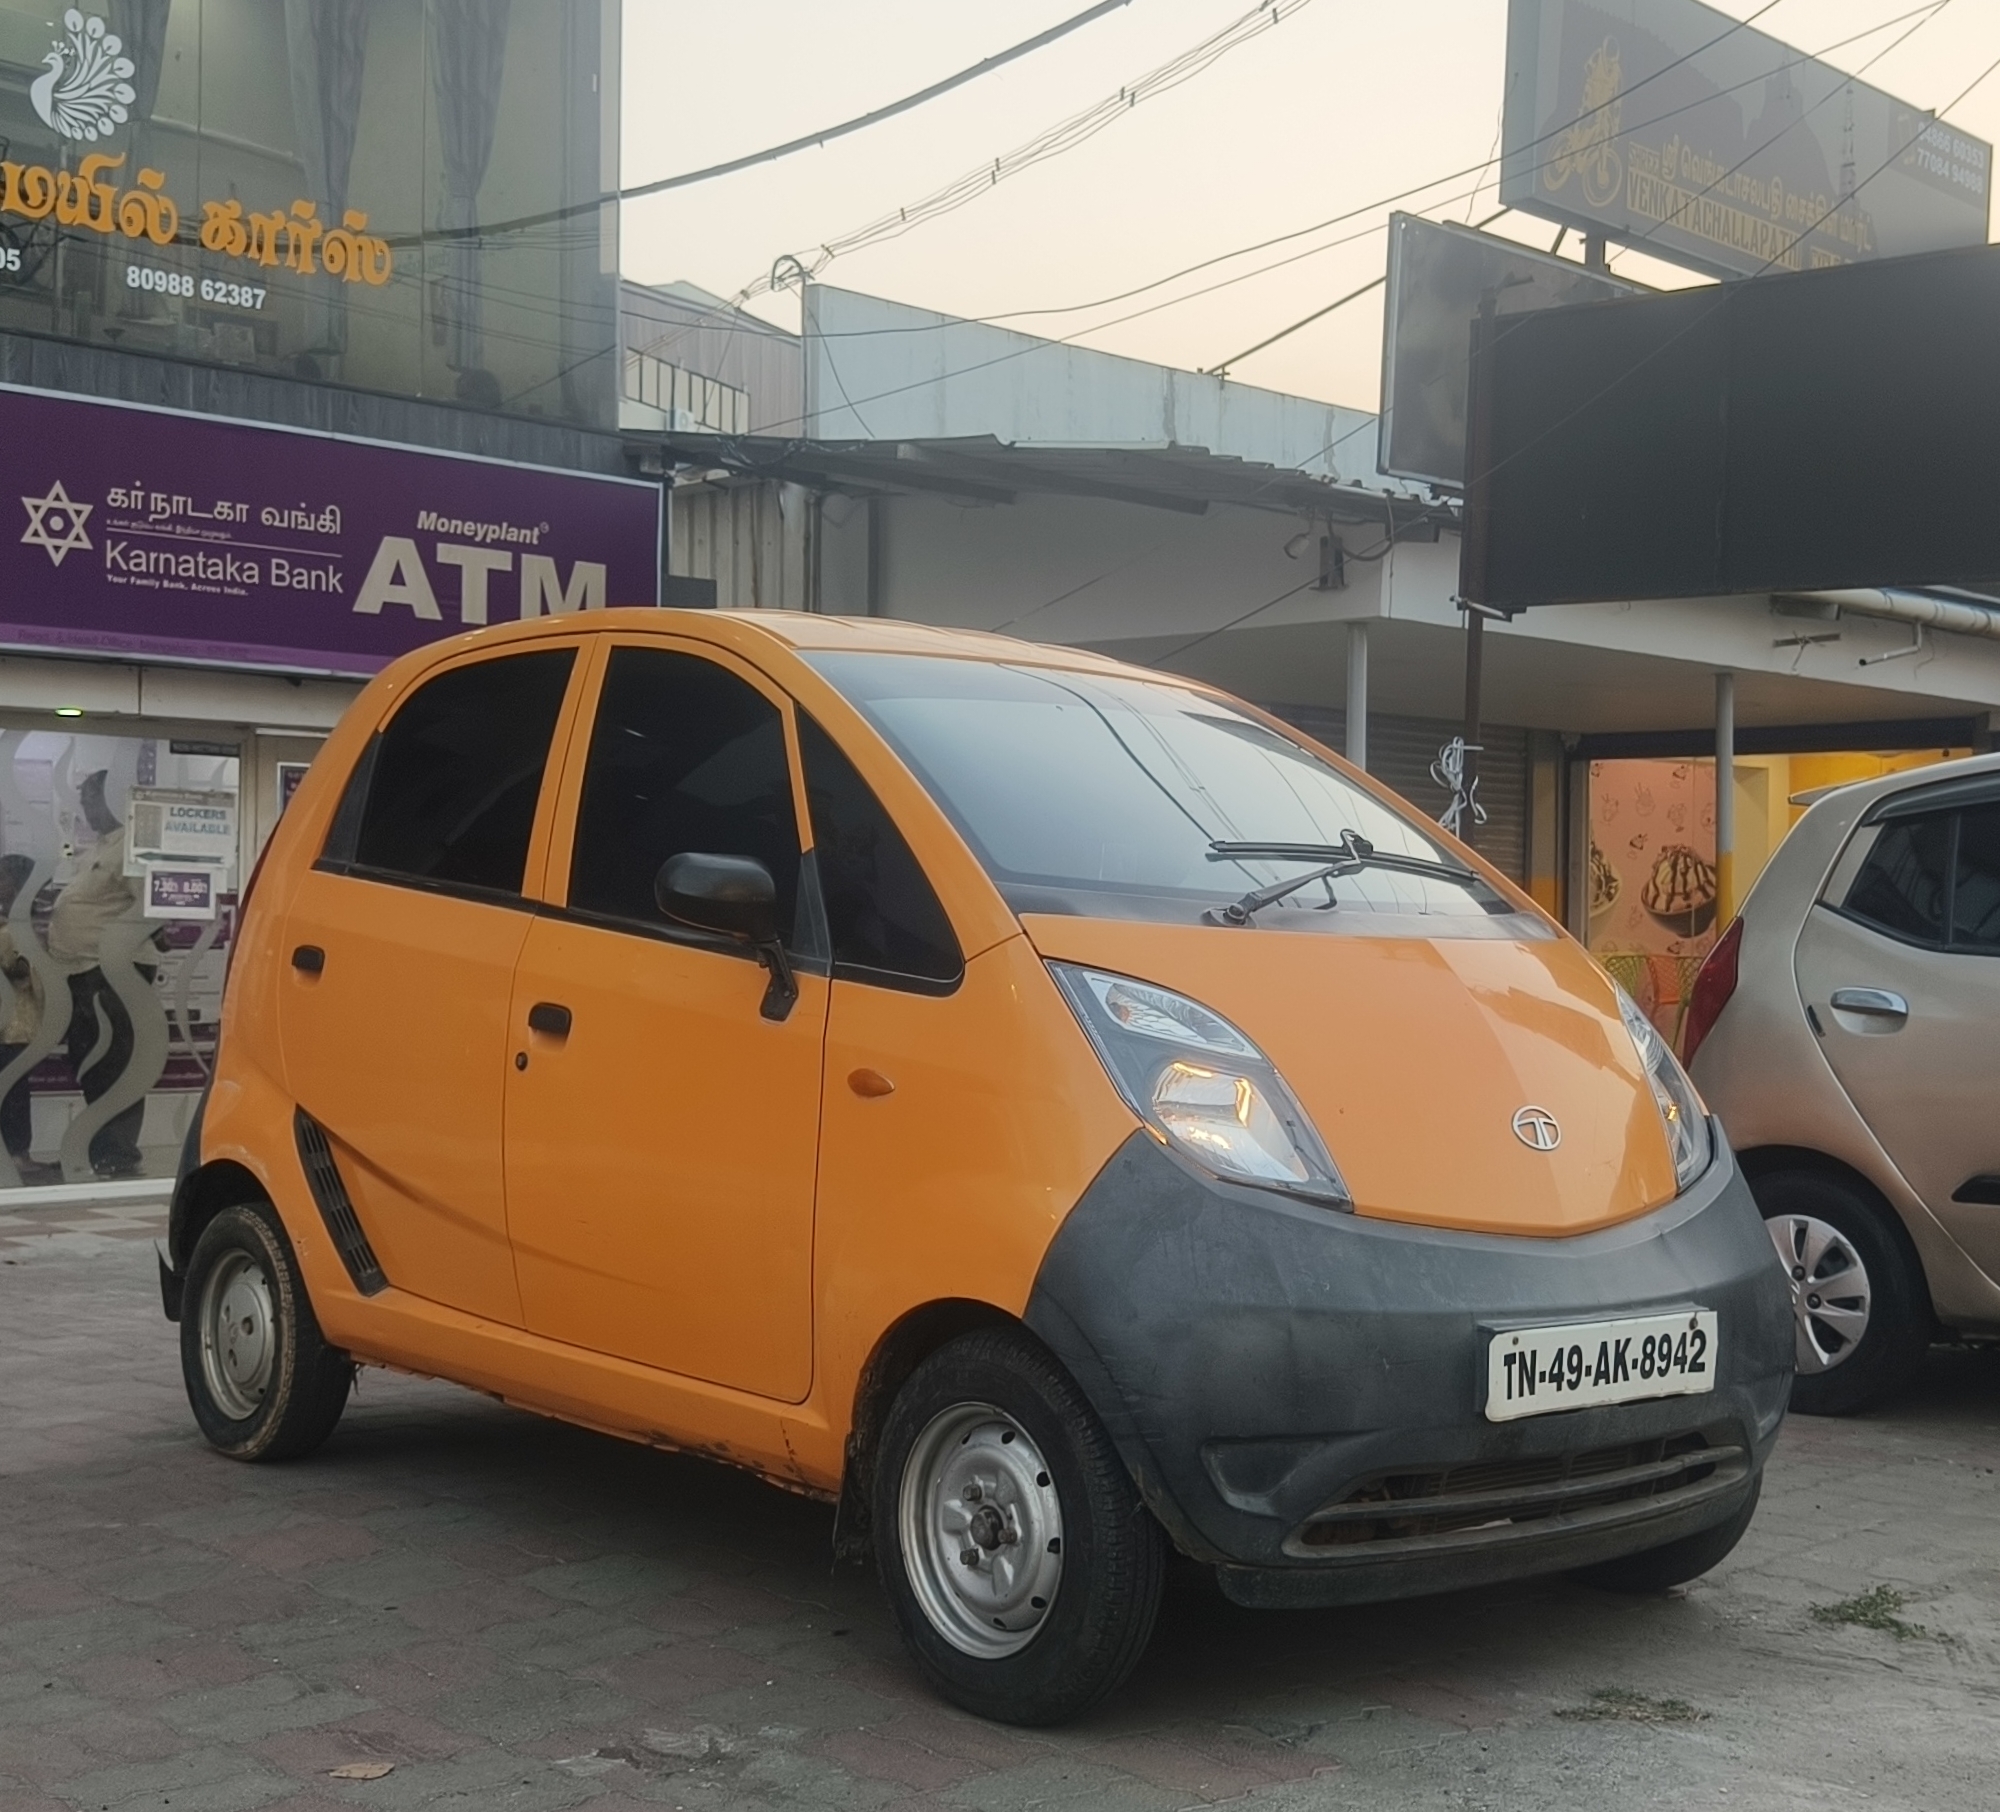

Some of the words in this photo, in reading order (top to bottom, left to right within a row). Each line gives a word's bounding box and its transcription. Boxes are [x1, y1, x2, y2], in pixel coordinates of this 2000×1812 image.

[0, 152, 179, 245] மயில்
[201, 198, 392, 286] கார்ஸ்
[126, 265, 195, 298] 80988
[200, 279, 266, 311] 62387
[106, 480, 250, 523] கர்நாடகா
[261, 502, 342, 535] வங்கி
[106, 539, 260, 585] Karnataka
[271, 558, 343, 594] Bank
[352, 535, 607, 626] ATM
[164, 820, 231, 835] AVAILABLE
[169, 806, 227, 820] LOCKERS
[1503, 1328, 1707, 1401] TN-49-AK-8942
